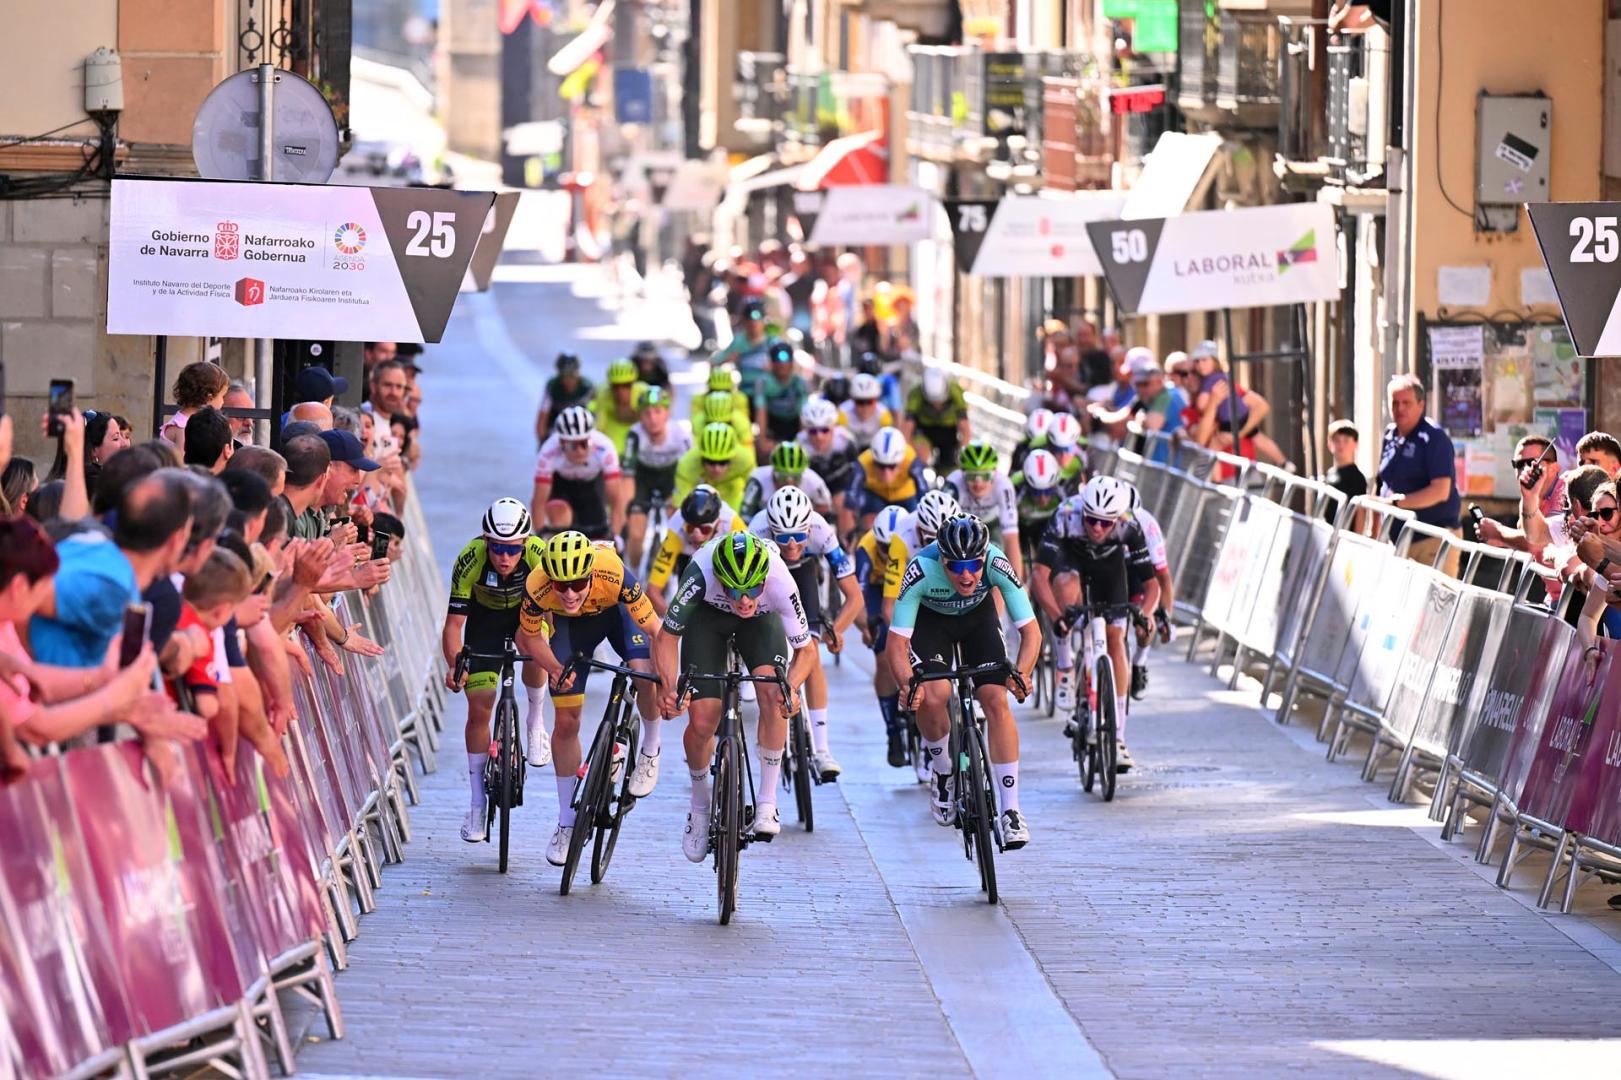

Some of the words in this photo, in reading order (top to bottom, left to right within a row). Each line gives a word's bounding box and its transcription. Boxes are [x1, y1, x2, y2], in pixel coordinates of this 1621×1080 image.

[958, 205, 987, 232] 75
[151, 230, 210, 243] Gobierno
[405, 210, 456, 258] 25
[1569, 216, 1620, 263] 25
[244, 234, 315, 249] Nafarroako
[1111, 229, 1148, 264] 50
[140, 245, 156, 255] de
[159, 246, 209, 258] Navarra
[243, 249, 306, 263] Gobernua
[333, 261, 365, 271] 2030
[1174, 252, 1273, 276] LABORAL
[133, 279, 161, 287] Instituto
[162, 280, 189, 288] Navarro
[203, 282, 231, 291] Deporte
[158, 287, 167, 295] de
[176, 288, 208, 297] Actividad
[269, 285, 308, 294] Nafarroako
[308, 287, 340, 296] Kirolaren
[341, 289, 352, 297] eta
[269, 293, 299, 302] Jarduera
[300, 294, 337, 303] Fisikoaren
[337, 297, 370, 305] Institutua
[679, 584, 702, 606] RGA
[789, 592, 802, 620] RGA
